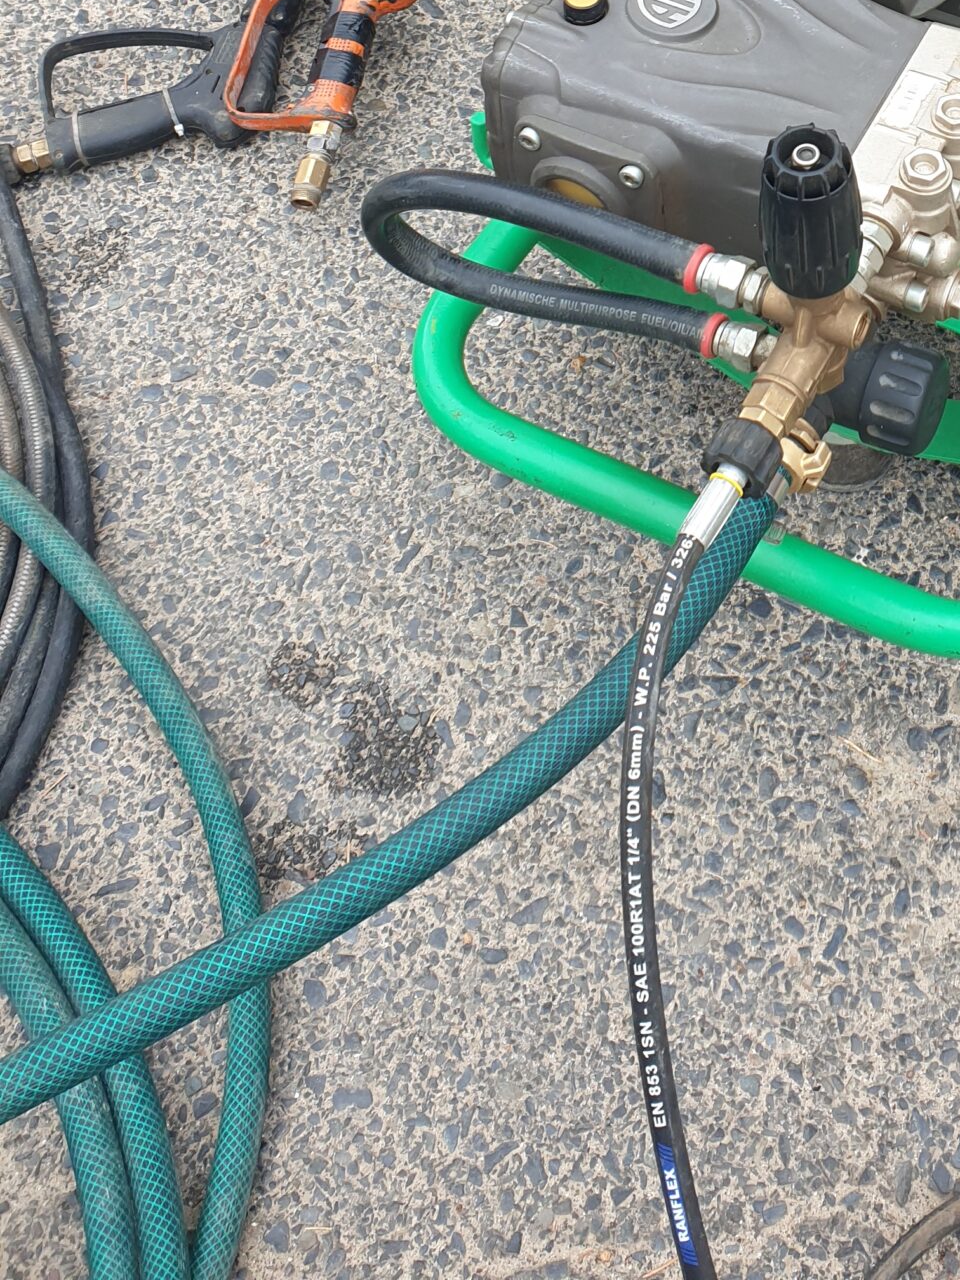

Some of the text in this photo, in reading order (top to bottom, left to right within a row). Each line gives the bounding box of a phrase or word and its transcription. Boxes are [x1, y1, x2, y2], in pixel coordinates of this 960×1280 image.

[489, 284, 557, 308] DYNAMISCHE
[559, 299, 637, 321] MULTIPURPOSE
[652, 582, 673, 617] Bar
[642, 620, 662, 656] 225
[633, 662, 653, 707] W.P.
[627, 725, 645, 781] 6mm)
[625, 785, 642, 823] (DN
[628, 871, 645, 957] 100R1AT
[632, 961, 650, 1003] SAE
[637, 1020, 657, 1058] 1SN
[643, 1064, 662, 1097] 853
[651, 1101, 667, 1128] EN
[662, 1166, 690, 1243] RANFLEX
